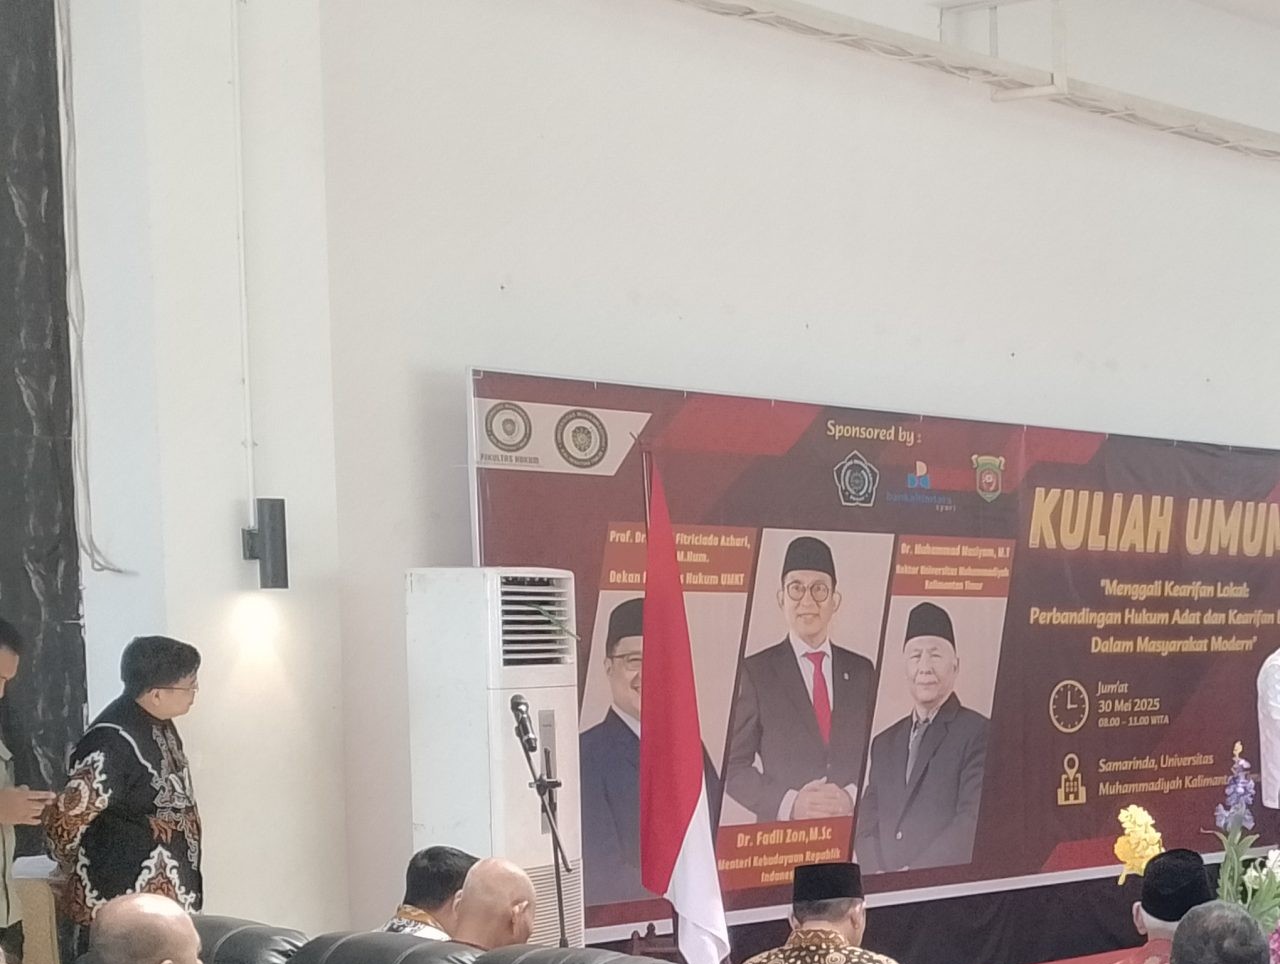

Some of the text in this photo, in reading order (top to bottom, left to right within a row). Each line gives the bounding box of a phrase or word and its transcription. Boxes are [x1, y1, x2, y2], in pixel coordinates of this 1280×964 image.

[827, 420, 894, 441] Sponsored
[898, 427, 914, 446] by
[1028, 487, 1174, 554] KULIAH
[610, 530, 633, 543] Prof.
[609, 570, 641, 584] Dekan
[686, 573, 719, 585] Hukum
[1164, 581, 1212, 600] Kearifan
[1030, 607, 1122, 629] Perbandingan
[1124, 608, 1169, 625] Hukum
[1171, 609, 1201, 625] Adat
[1203, 609, 1226, 625] dan
[1228, 609, 1275, 627] Kearifan
[1091, 636, 1134, 653] Dalam
[1136, 636, 1209, 656] Masyarakat
[1098, 698, 1160, 713] 30 Mei 2025
[1128, 715, 1149, 727] 11.00
[1151, 714, 1170, 726] WITA
[1099, 752, 1214, 773] Samarinda, Universitas
[1099, 776, 1183, 796] Muhammadiyah
[737, 833, 753, 848] Dr.
[757, 829, 784, 846] Fadli
[718, 847, 841, 871] Menteri Kebudayaan Republik
